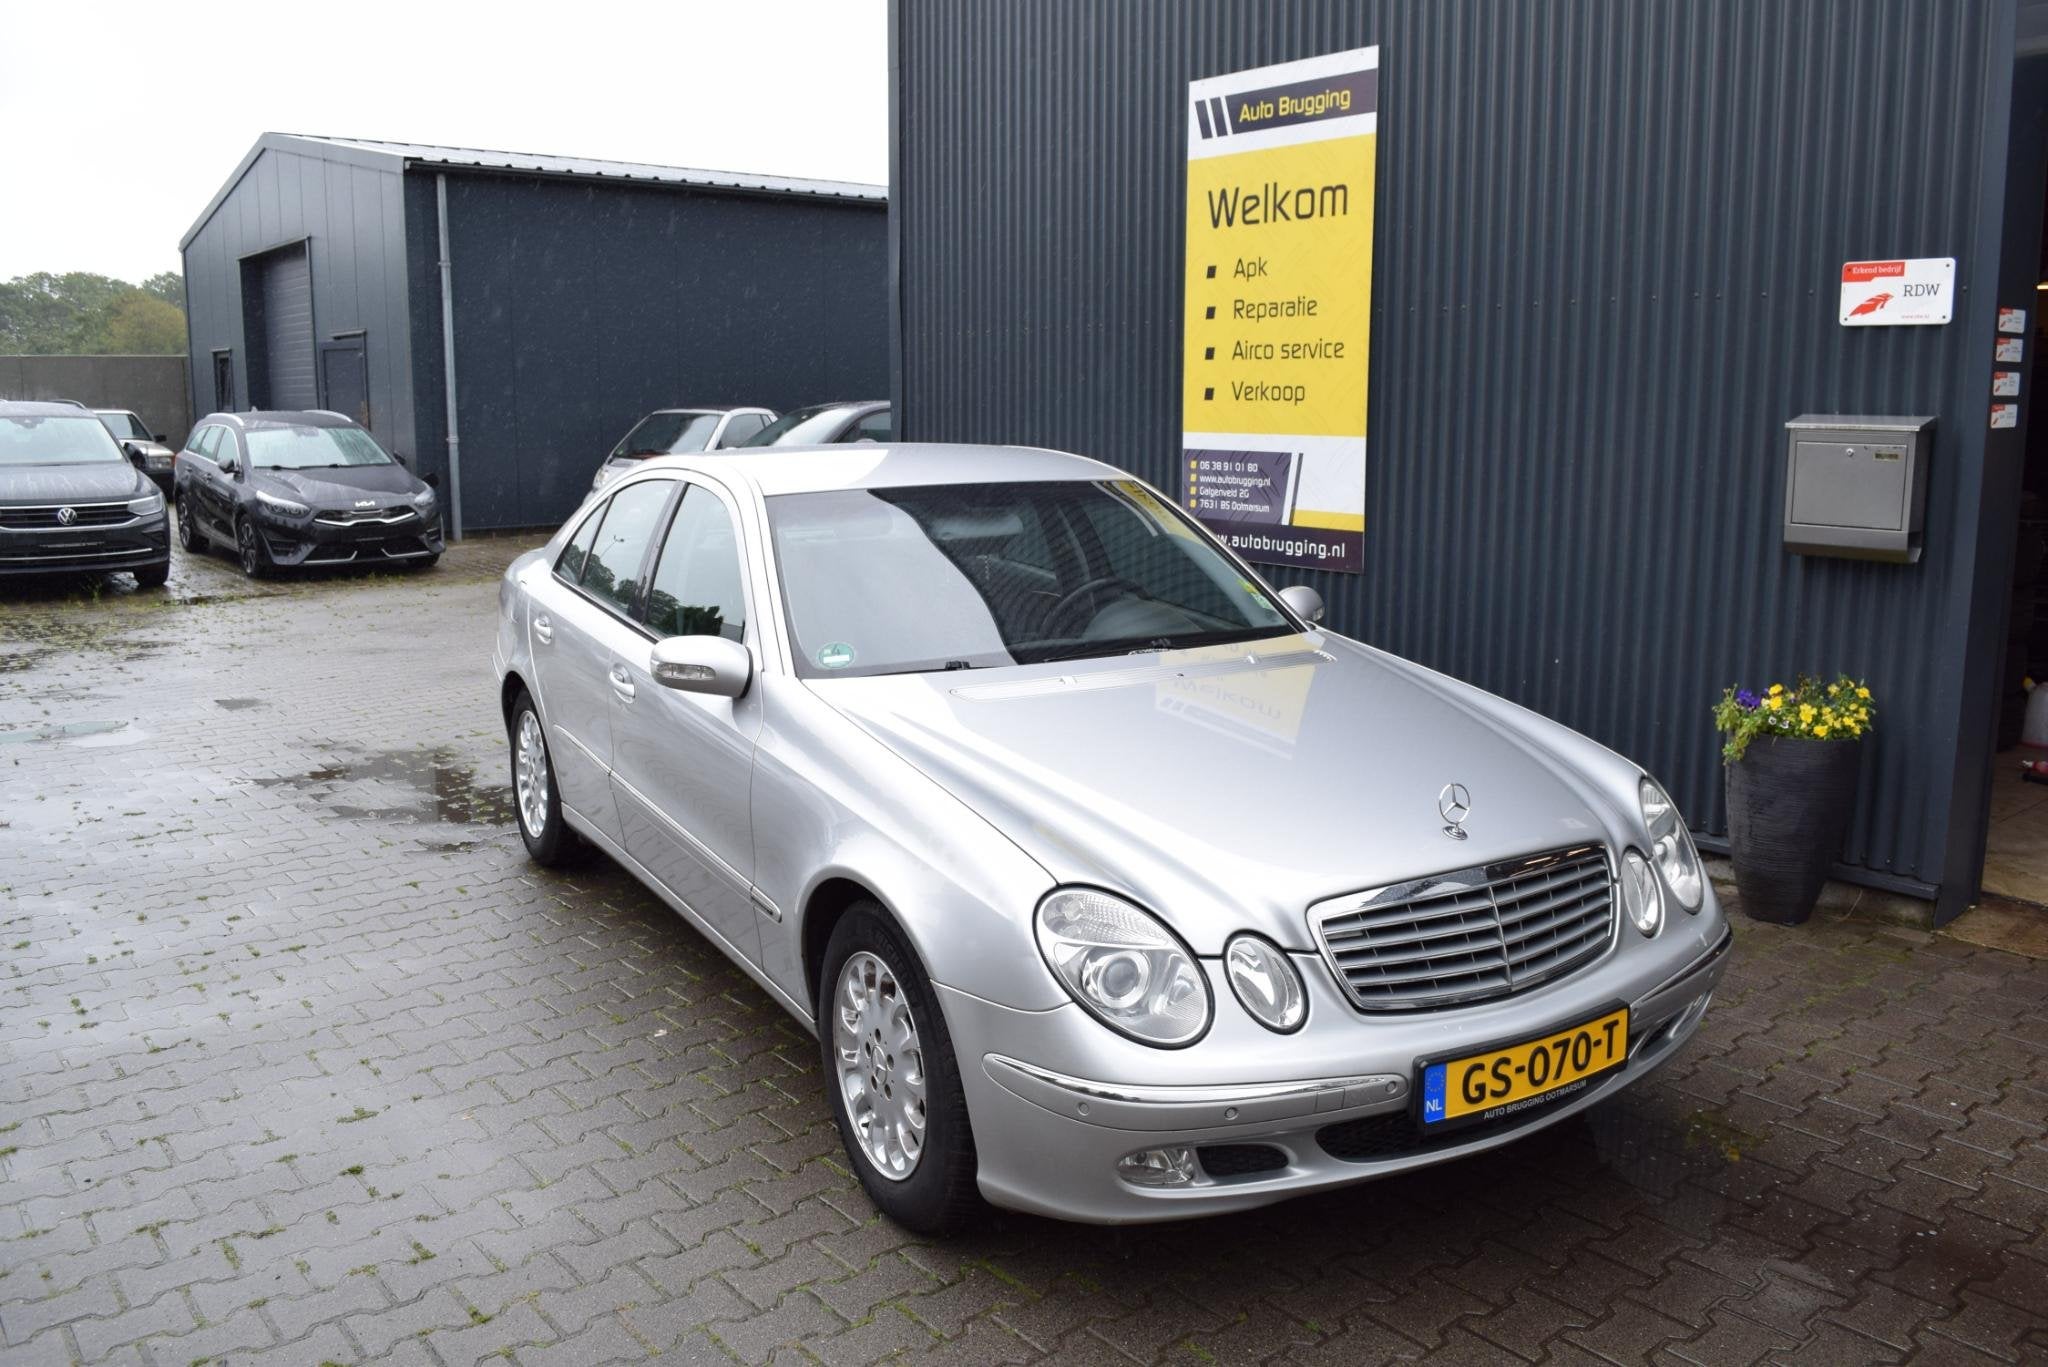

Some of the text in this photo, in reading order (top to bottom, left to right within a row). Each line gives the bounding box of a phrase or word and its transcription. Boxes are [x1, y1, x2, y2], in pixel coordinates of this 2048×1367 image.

[1239, 89, 1351, 123] Auto Brugging
[1207, 182, 1348, 229] Welkom
[1233, 256, 1268, 282] Apk
[1852, 265, 1902, 275] Erkend bedrijf
[1903, 283, 1941, 297] RDW
[1232, 296, 1318, 323] Reparatie
[1231, 338, 1345, 361] Airco service
[1231, 381, 1306, 406] Verkoop
[1199, 461, 1210, 471] 06
[1223, 462, 1233, 471] 91
[1235, 462, 1245, 472] 01
[1199, 475, 1271, 488] www.autobrugging.nl
[1199, 486, 1250, 498] Galgenveld 2G
[1199, 499, 1218, 509] 7631
[1462, 1019, 1619, 1105] GS-070-T
[1425, 1099, 1443, 1112] NL
[1484, 1079, 1587, 1119] AUTO BRUGGING OOTMARSUM
